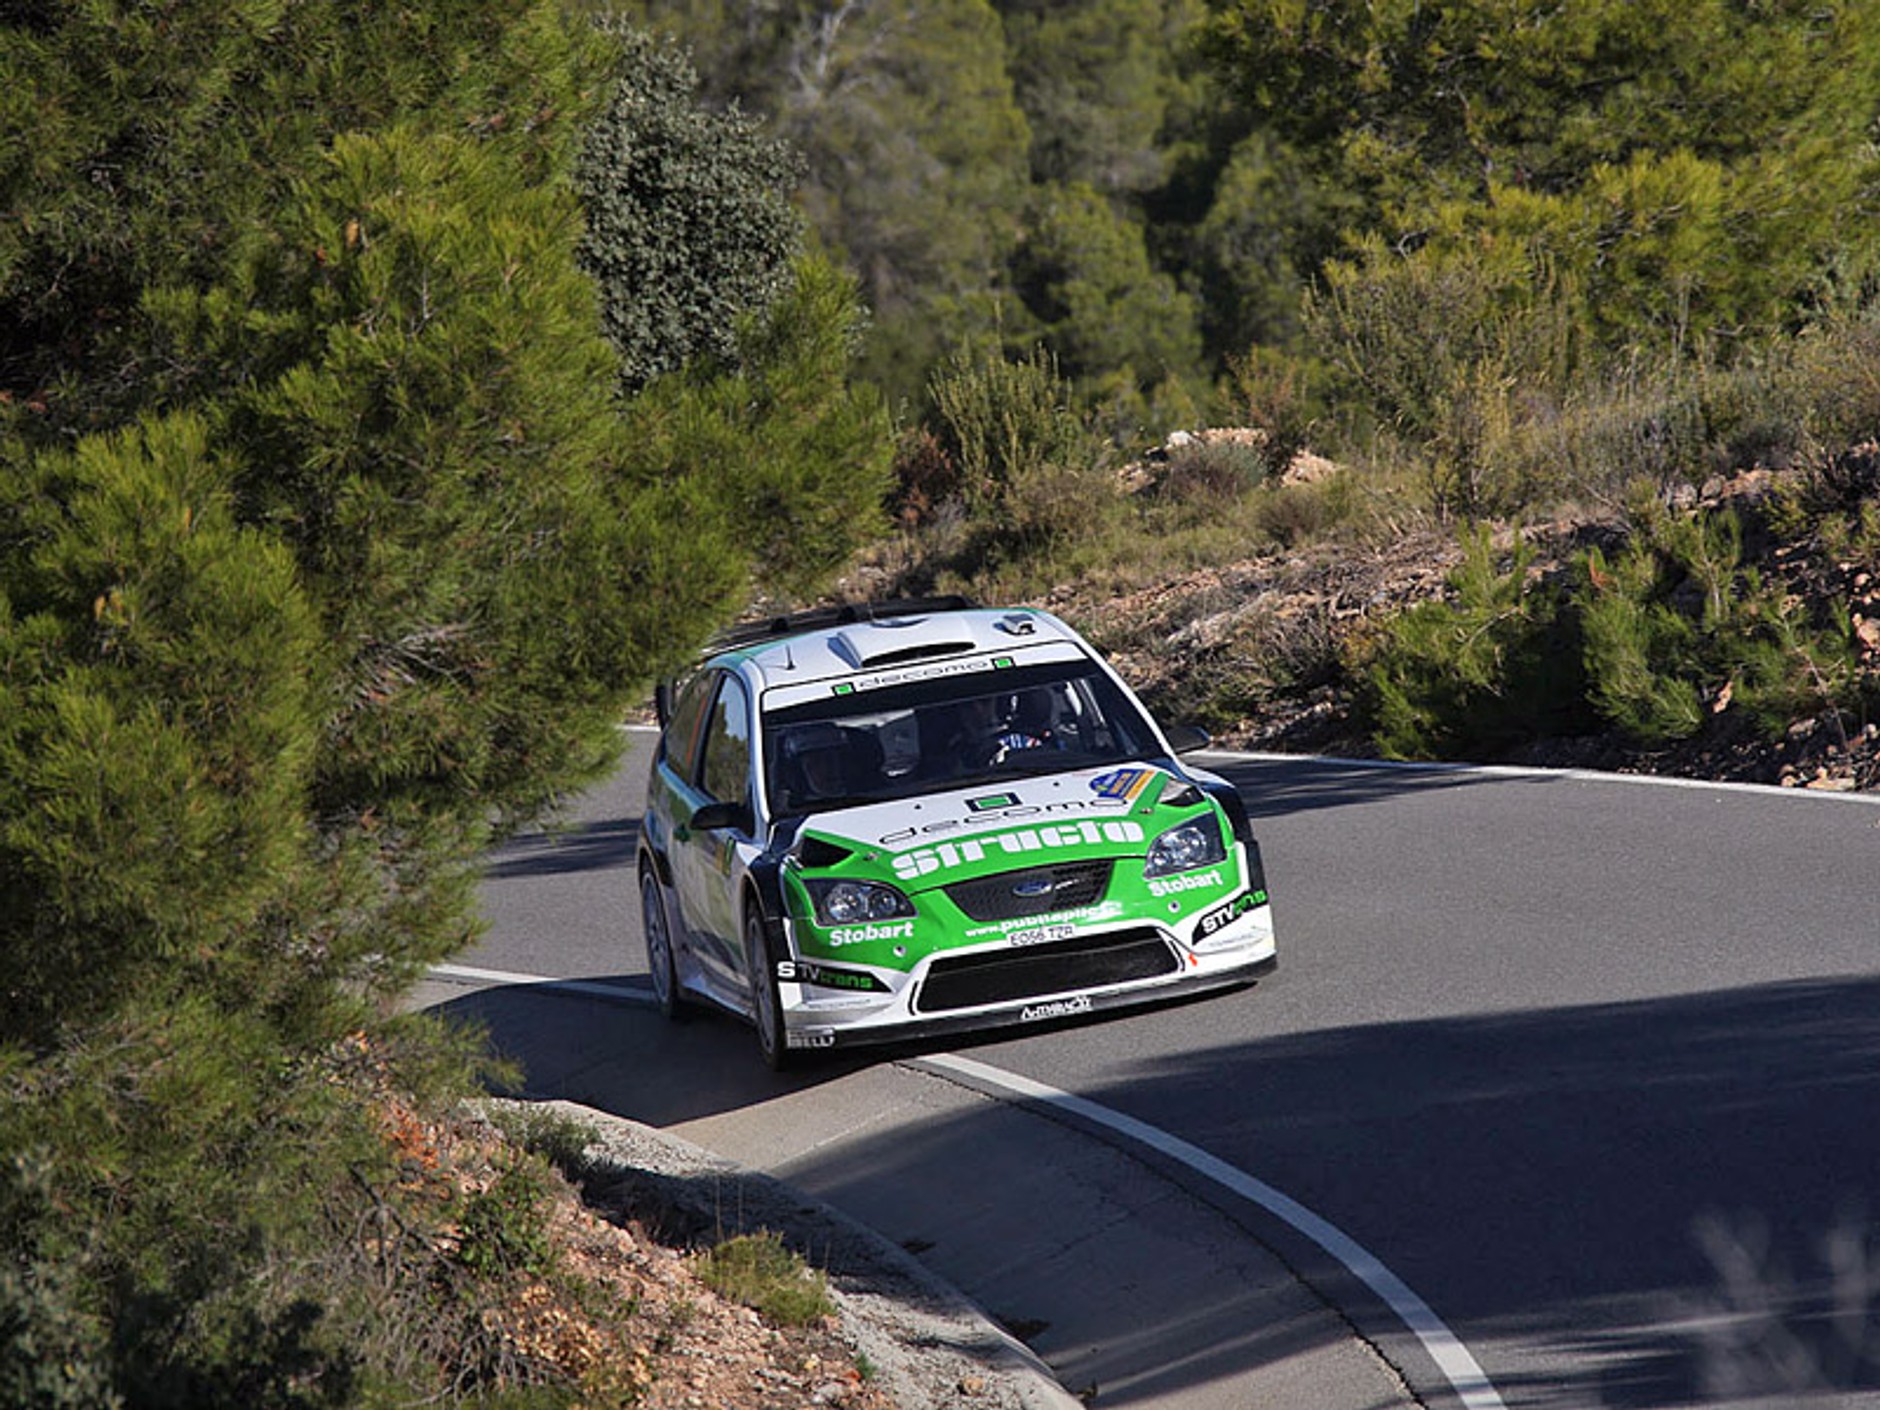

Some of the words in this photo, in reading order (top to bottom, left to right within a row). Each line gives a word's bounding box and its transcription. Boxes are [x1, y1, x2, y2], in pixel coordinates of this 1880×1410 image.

[859, 661, 988, 688] decomo
[879, 798, 1128, 845] decomo
[1147, 869, 1223, 897] Stobart
[829, 922, 914, 947] Stobart
